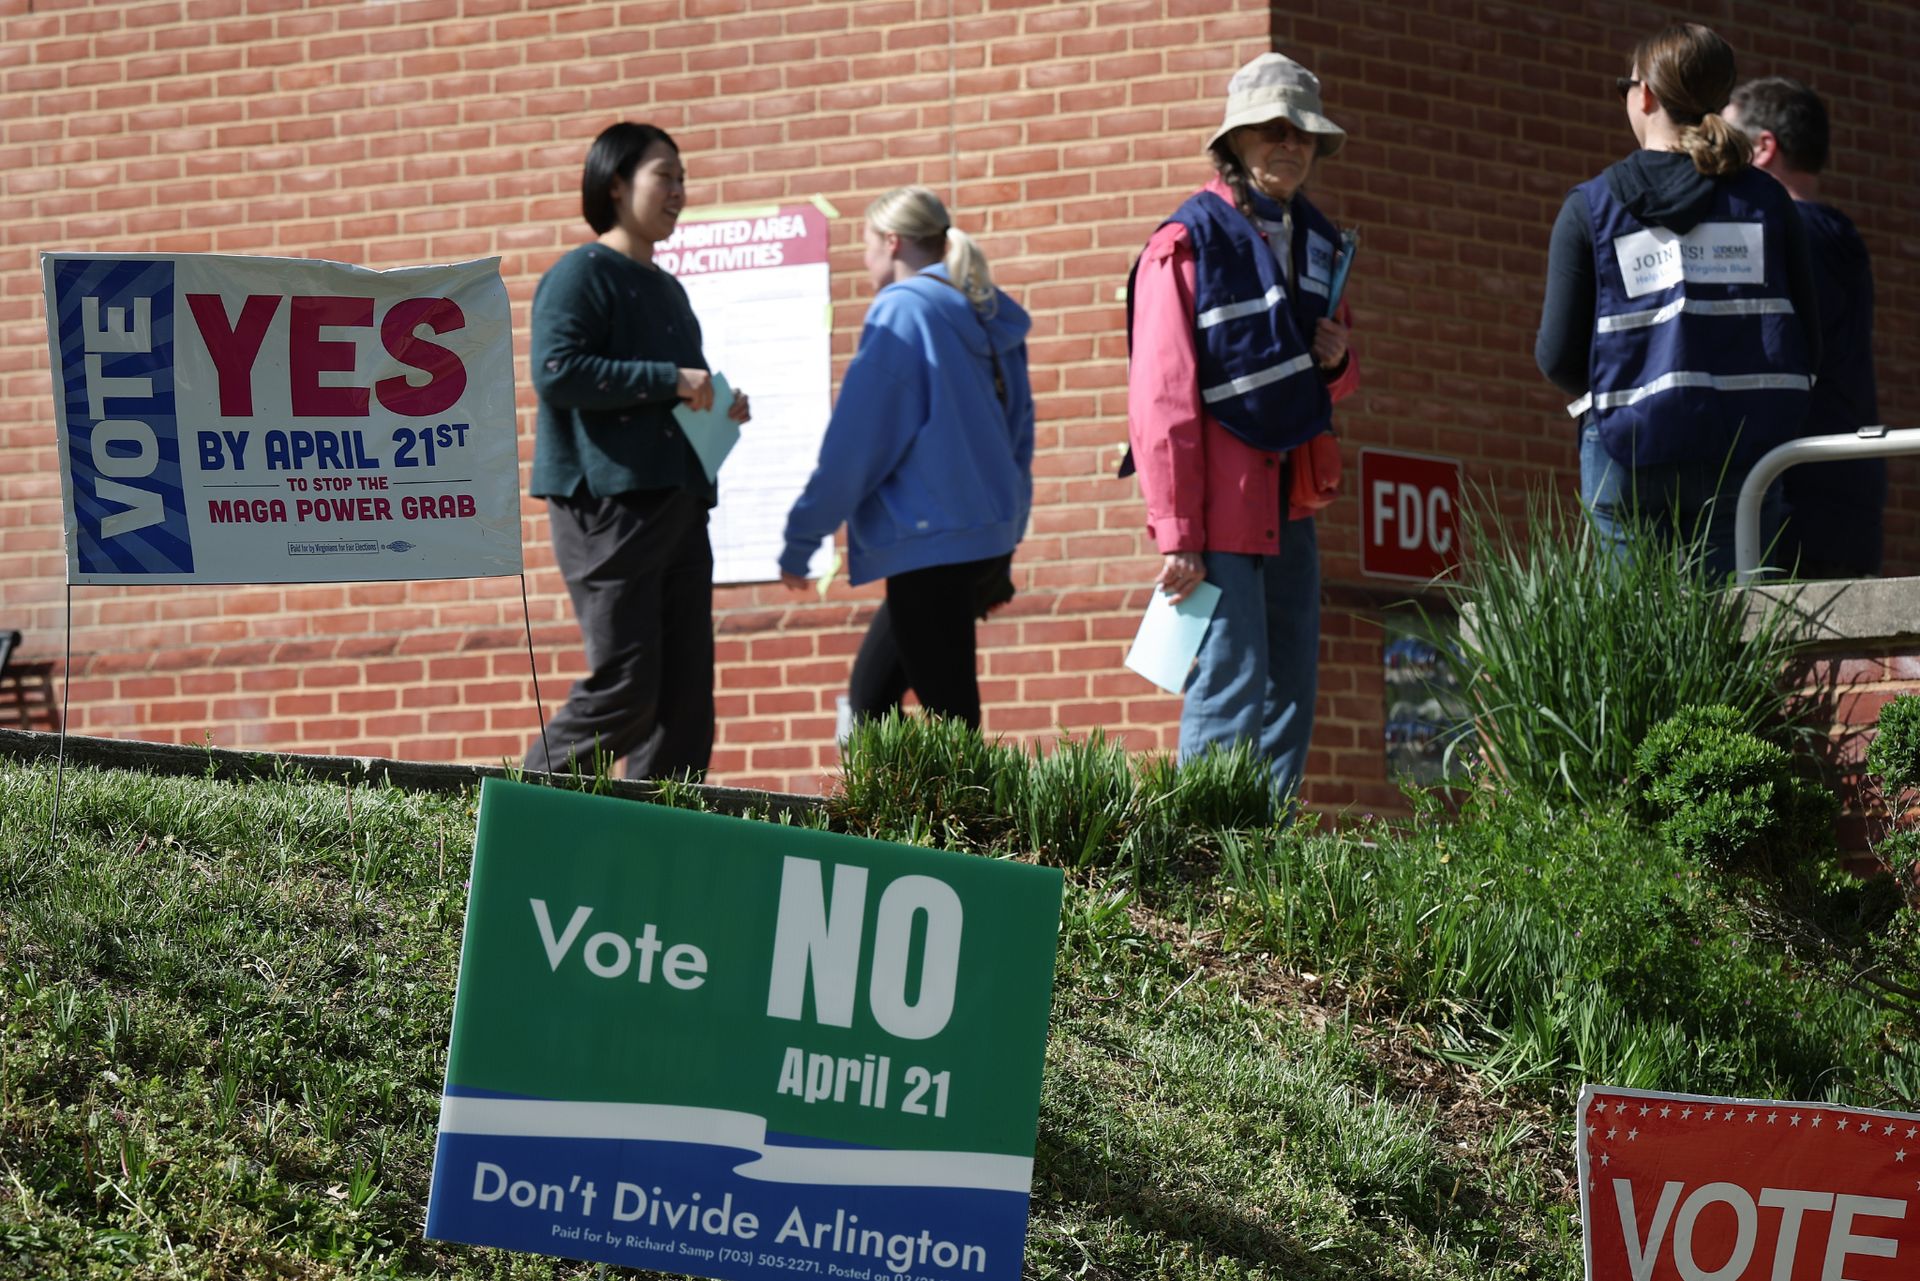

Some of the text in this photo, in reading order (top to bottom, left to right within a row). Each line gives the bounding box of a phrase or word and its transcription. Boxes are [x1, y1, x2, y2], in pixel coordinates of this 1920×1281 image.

[651, 242, 784, 275] ND ACTIVITIES
[753, 214, 807, 242] AREA
[1632, 243, 1704, 272] JOIN US!
[185, 293, 467, 417] YES
[81, 296, 166, 539] VOTE
[197, 423, 470, 470] BY APRIL 21ST
[208, 494, 477, 523] MAGA POWER GRAB
[286, 476, 389, 491] TO STOP THE
[1372, 479, 1451, 555] FDC
[529, 855, 964, 1040] Vote NO
[777, 1047, 951, 1118] April 21
[472, 1162, 987, 1273] Don't Divide Arlington
[1612, 1178, 1908, 1281] VOTE
[551, 1225, 580, 1240] Paid
[583, 1228, 602, 1242] for
[606, 1231, 622, 1248] by
[625, 1235, 675, 1253] Richard
[679, 1242, 715, 1261] Samp
[718, 1248, 753, 1266] (703)
[758, 1253, 823, 1274] 505-2271.
[828, 1263, 870, 1280] Posted
[874, 1273, 890, 1281] on
